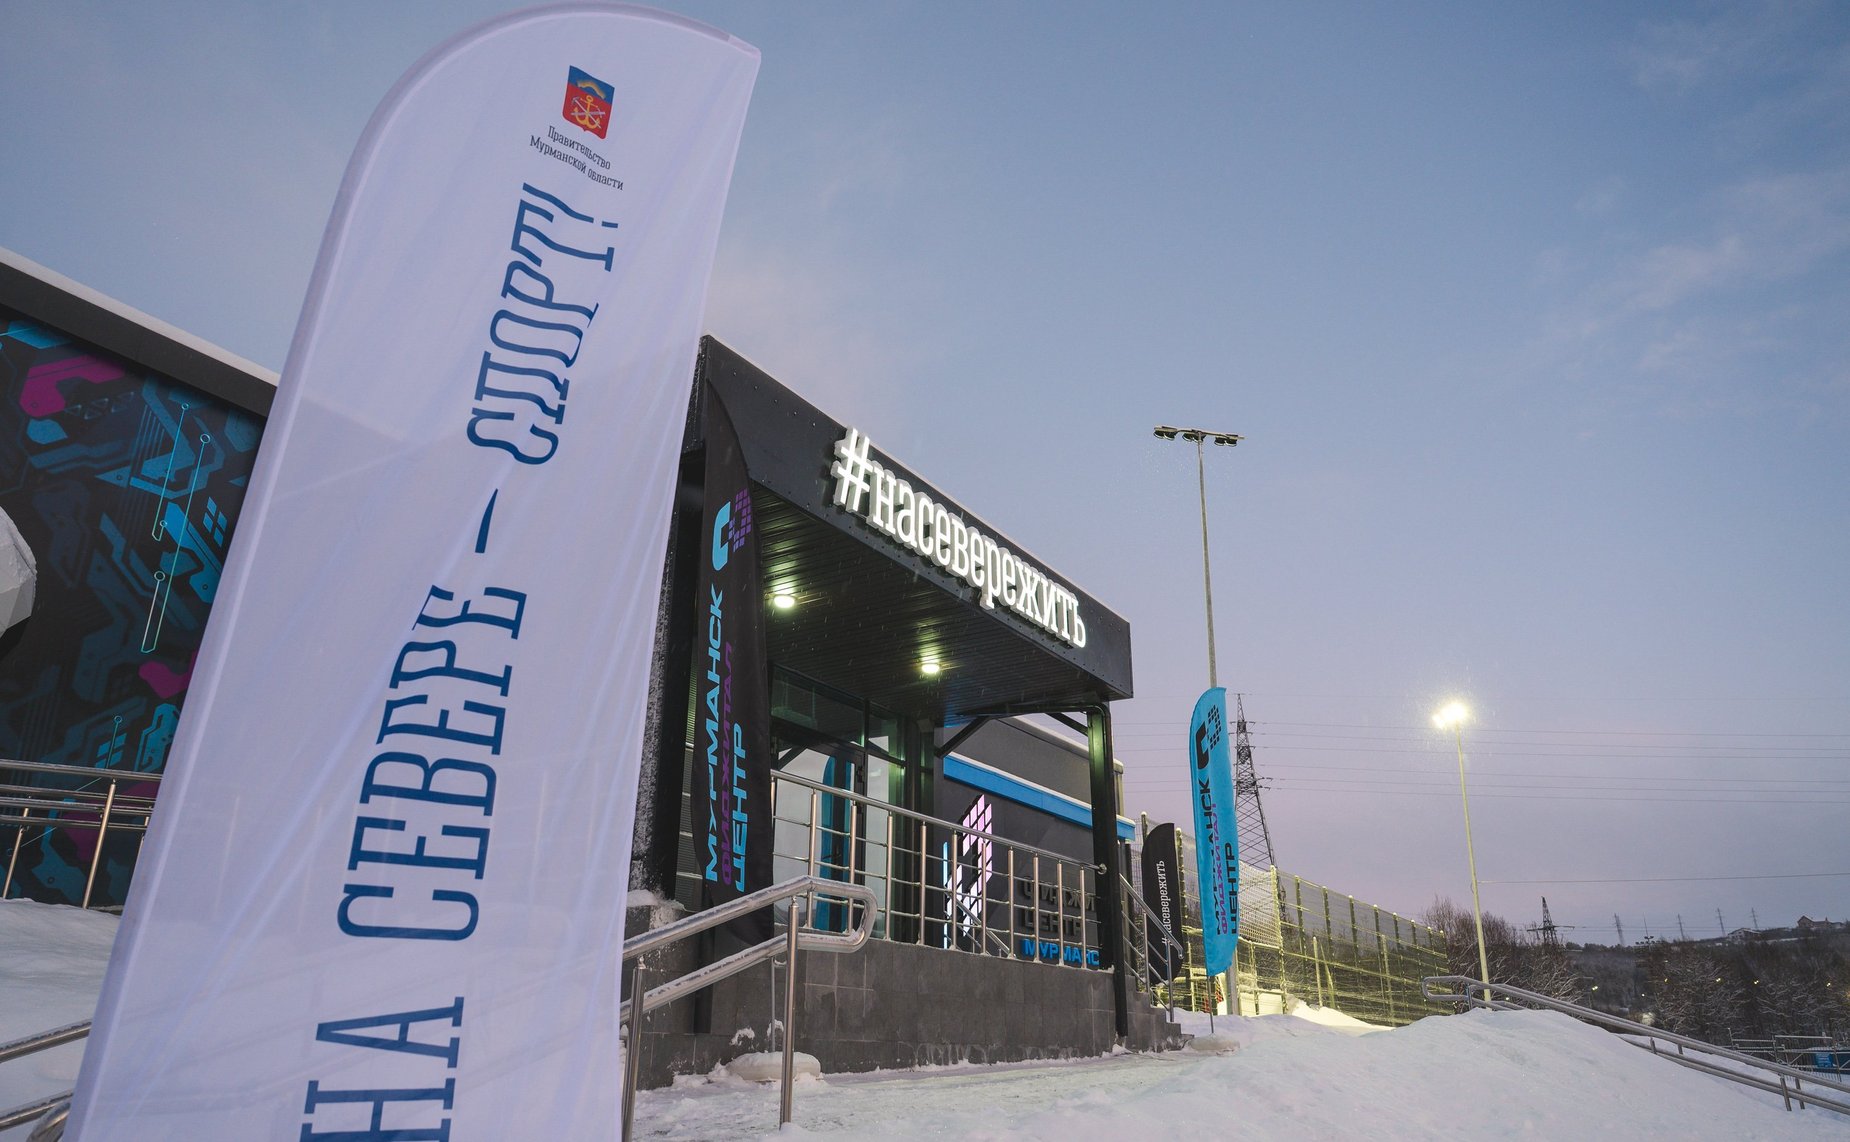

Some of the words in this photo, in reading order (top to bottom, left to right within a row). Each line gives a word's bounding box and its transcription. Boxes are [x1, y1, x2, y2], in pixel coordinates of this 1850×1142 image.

[530, 135, 587, 174] Мурманской
[587, 167, 624, 191] области
[547, 125, 611, 170] Правительство
[466, 183, 619, 465] СПОРТ!
[831, 425, 1087, 648] #насевережить
[337, 585, 527, 942] СЕВЕРЕ
[705, 583, 723, 882] МУРМАНСК
[721, 641, 732, 886] ФИДЖИТАЛ
[732, 722, 748, 893] ЦЕНТР
[1211, 802, 1228, 935] ФИДЖИТАЛ
[1021, 938, 1100, 966] МУРМАНС
[1156, 860, 1173, 946] #асевережить
[1224, 842, 1238, 935] ЦЕНТР
[300, 996, 464, 1142] НА
